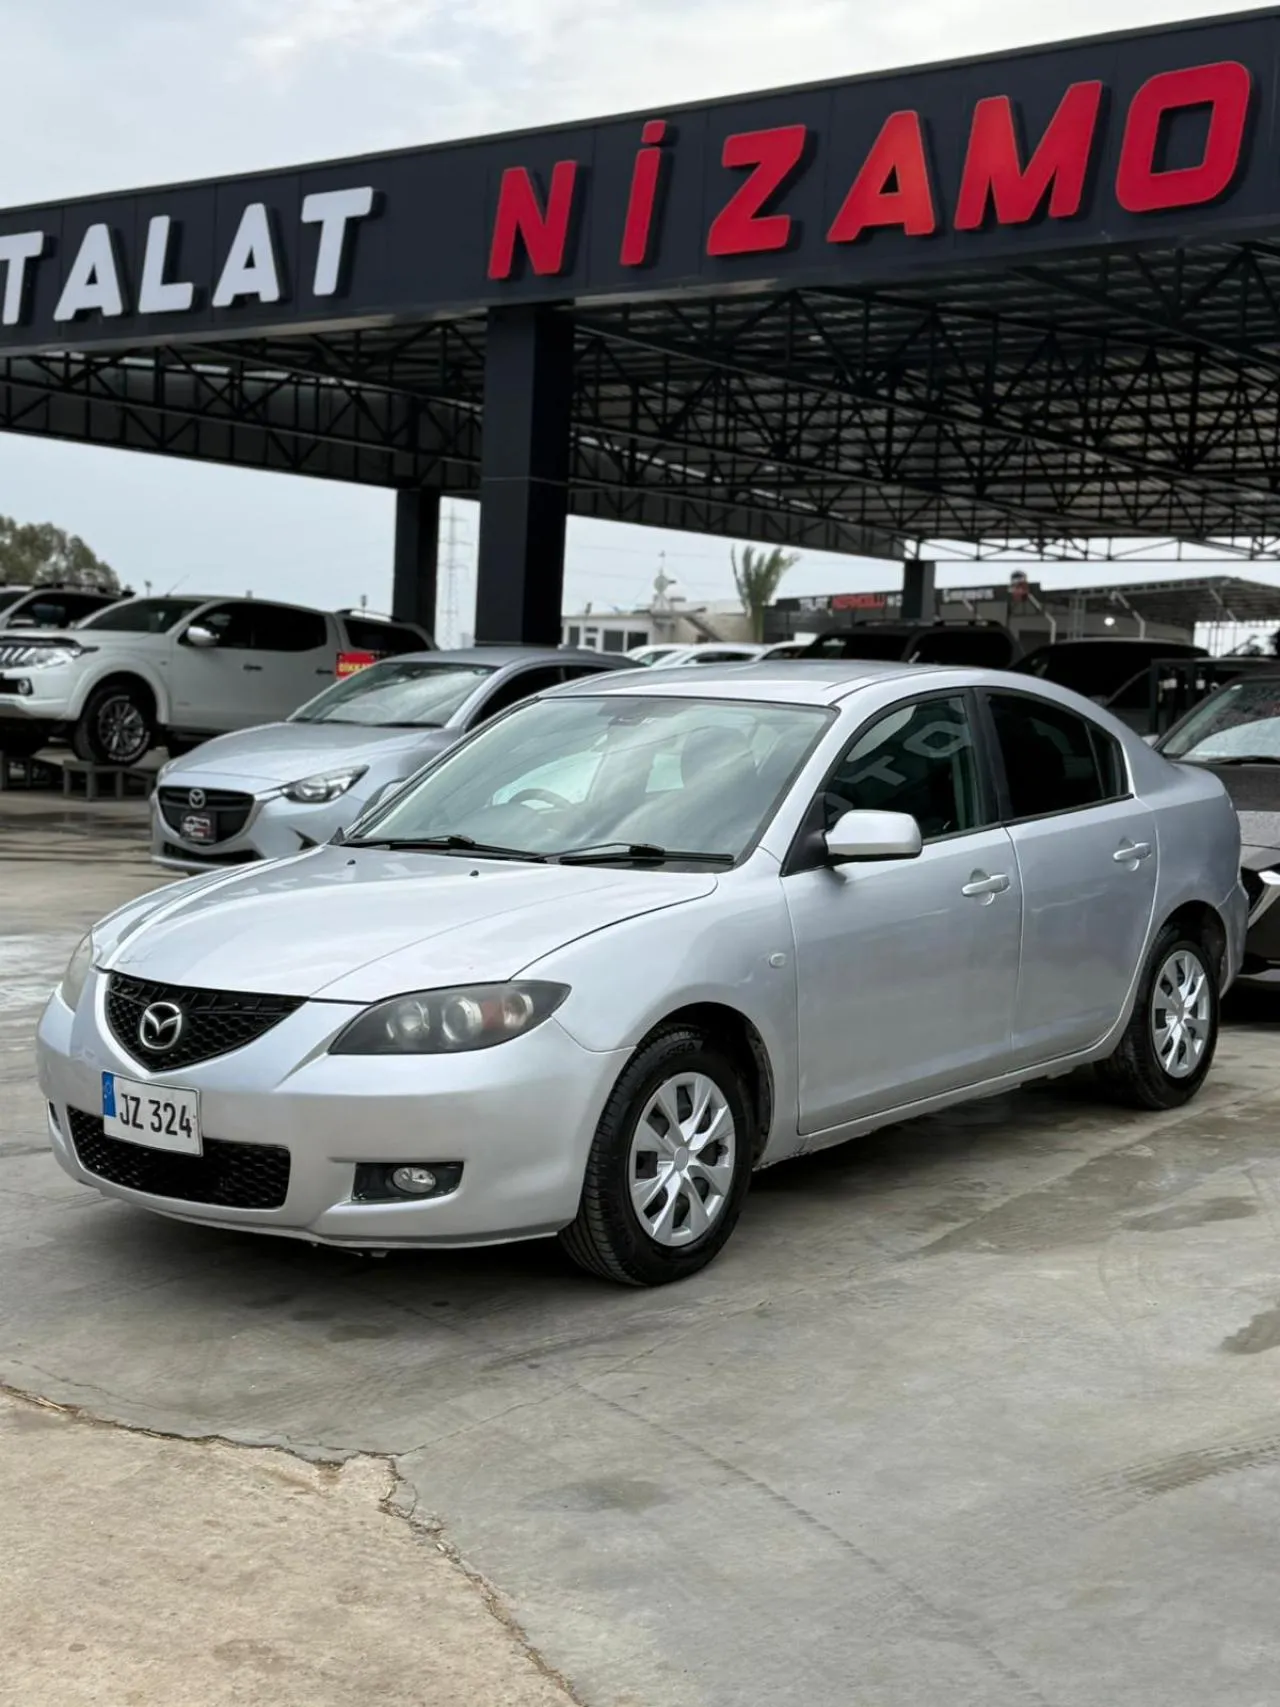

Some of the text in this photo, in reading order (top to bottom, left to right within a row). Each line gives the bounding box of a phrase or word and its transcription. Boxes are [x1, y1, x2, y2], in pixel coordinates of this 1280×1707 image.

[0, 60, 1250, 325] TALAT NİZAMO
[119, 1093, 192, 1139] JZ 324
